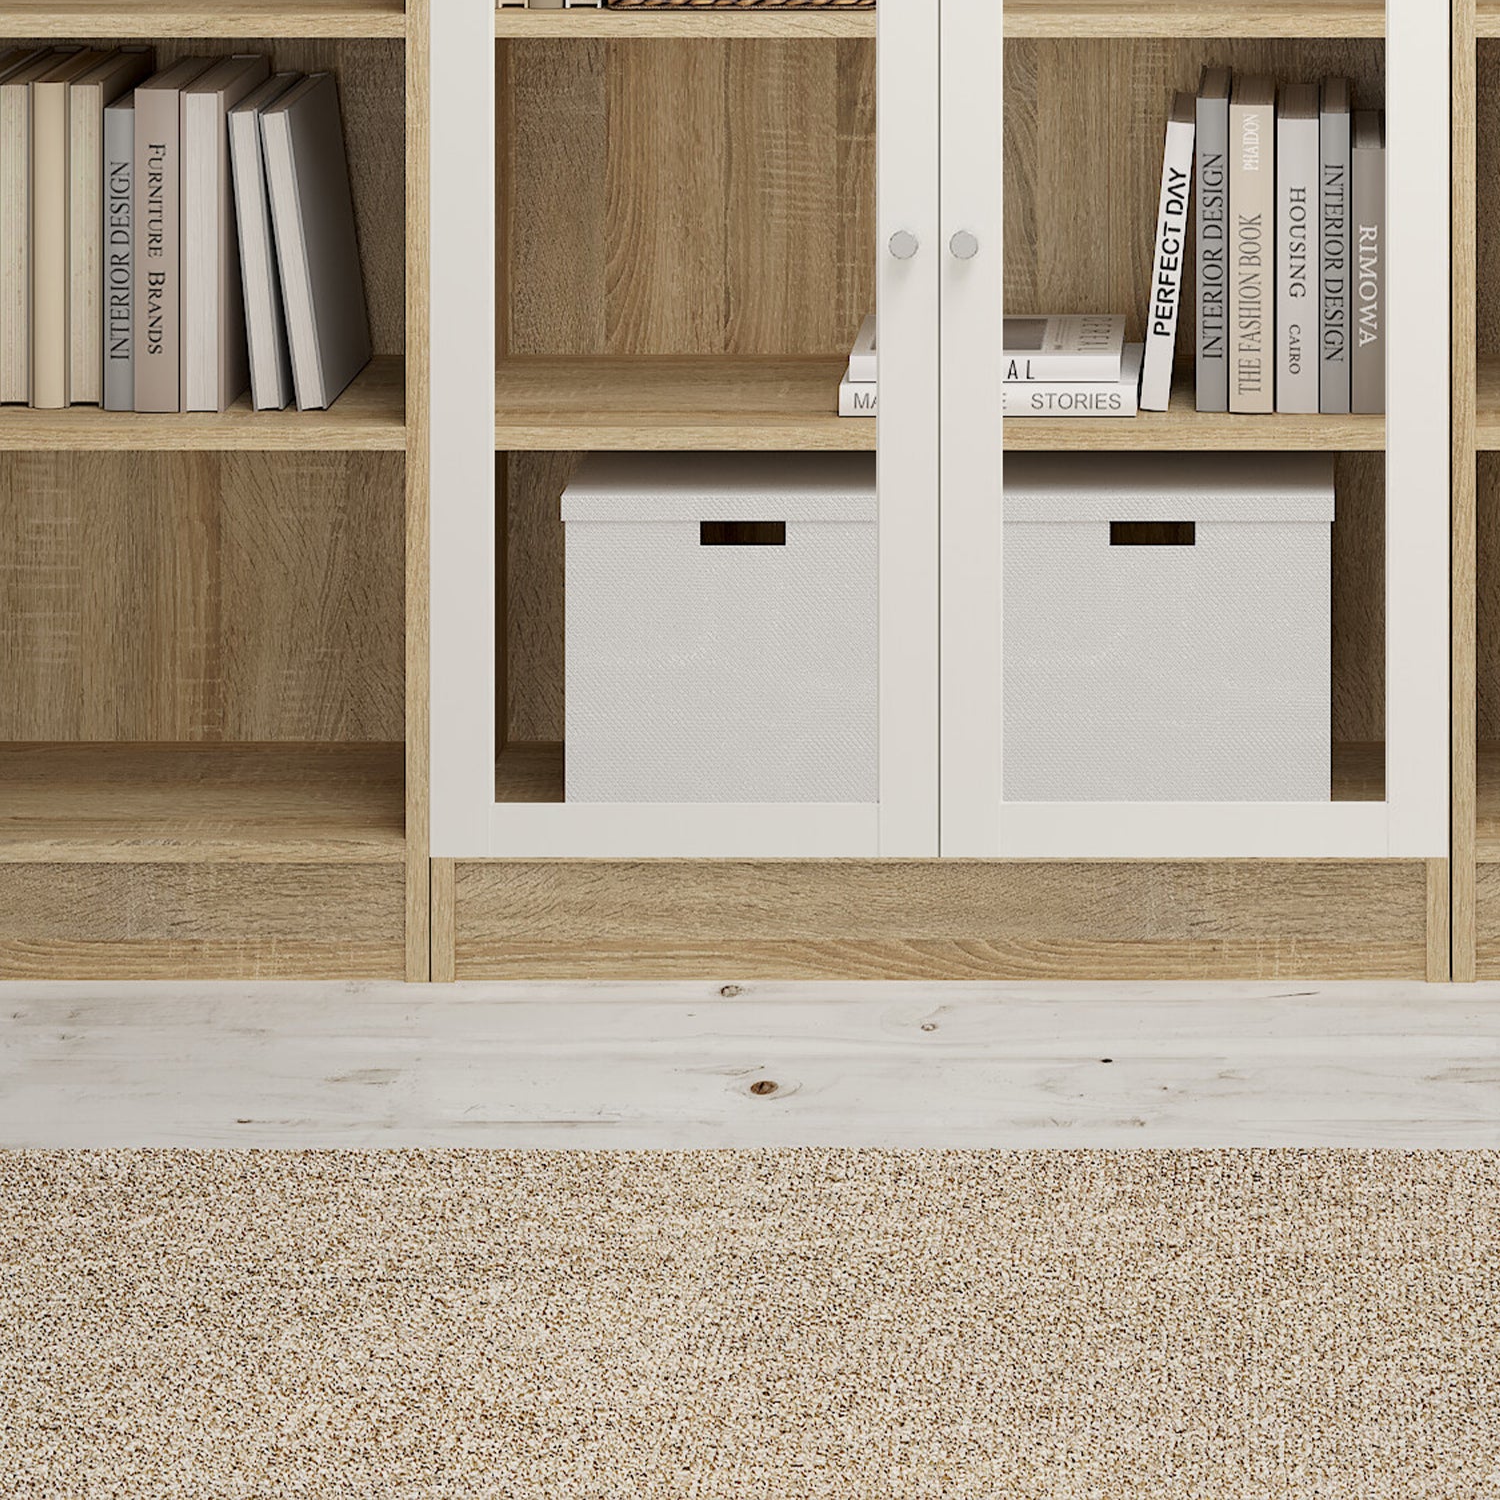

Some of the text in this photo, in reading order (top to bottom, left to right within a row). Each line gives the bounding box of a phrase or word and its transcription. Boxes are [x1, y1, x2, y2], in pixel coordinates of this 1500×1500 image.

[1242, 112, 1260, 172] PHAIDON
[110, 161, 131, 361] INTERIOR DESIGN
[147, 144, 167, 356] FURNITURE BRANDS
[1152, 166, 1188, 337] PERFECT DAY
[1201, 152, 1224, 360] INTERIOR DESIGN
[1237, 212, 1262, 396] THE FASHION BOOK
[1288, 186, 1307, 299] HOUSING
[1323, 163, 1345, 363] INTERIOR DESIGN
[1358, 224, 1379, 348] RIMOWA
[1030, 392, 1122, 410] STORIES
[1288, 323, 1301, 376] CAIRO
